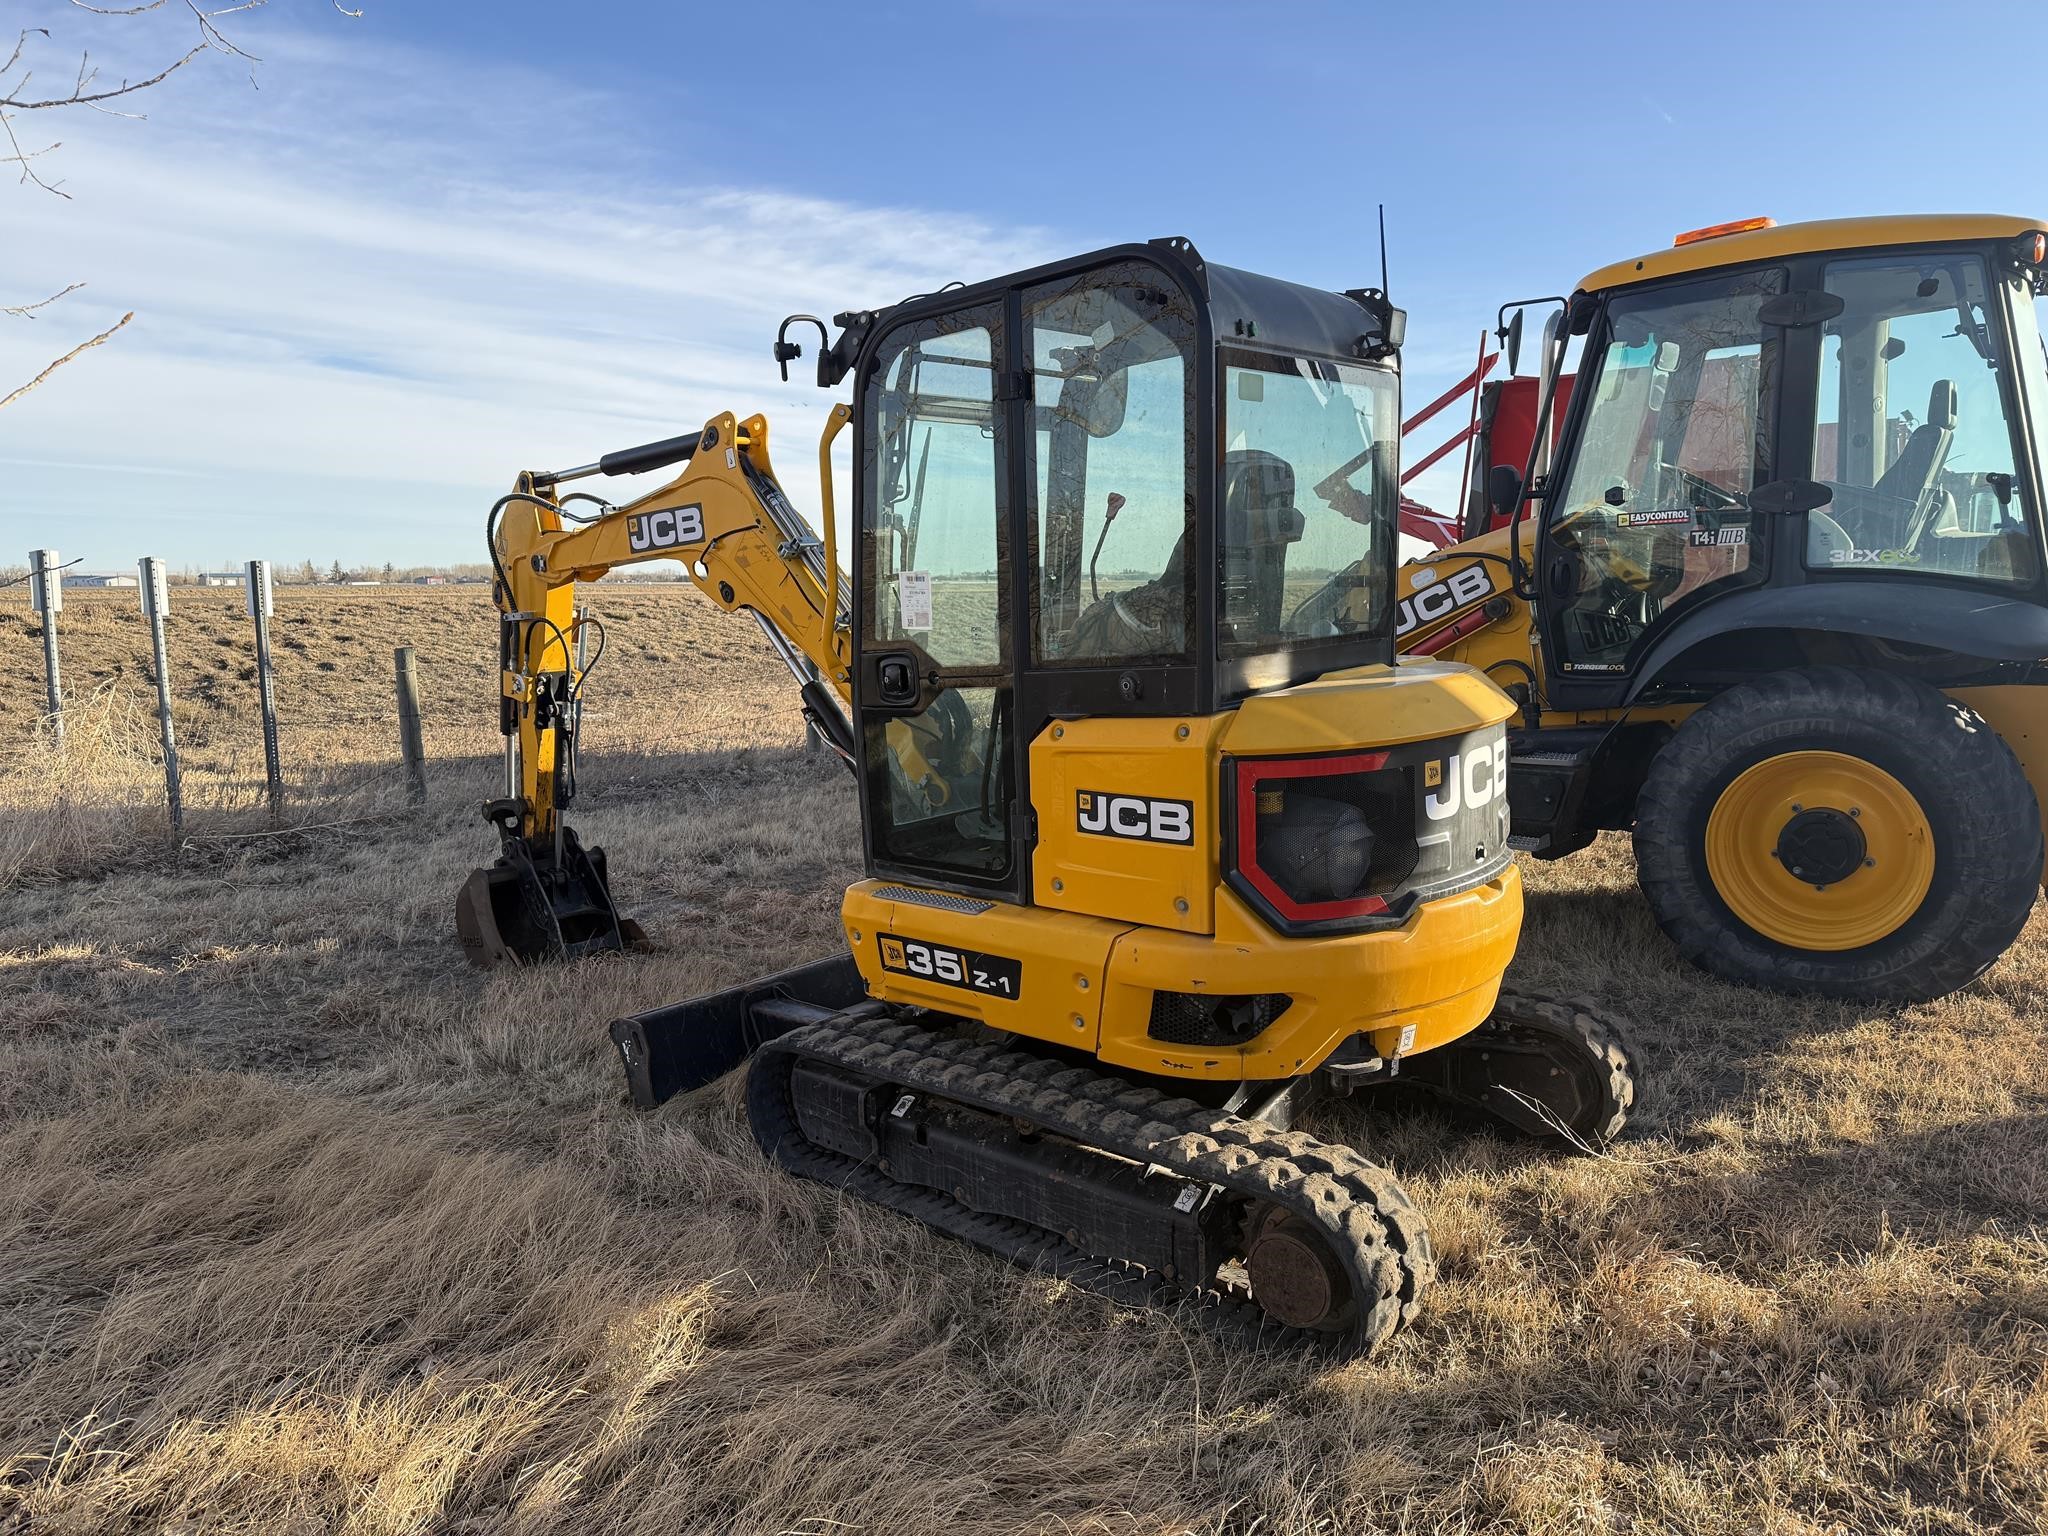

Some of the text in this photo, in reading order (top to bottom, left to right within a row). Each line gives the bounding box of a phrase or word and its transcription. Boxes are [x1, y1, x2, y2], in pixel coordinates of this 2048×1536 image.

[630, 507, 703, 550] JCB
[1630, 510, 1689, 525] EASYCONTROL
[1691, 531, 1716, 545] T4i
[1396, 566, 1491, 636] JCB
[1080, 795, 1191, 841] JCB
[906, 943, 1011, 993] 35 Z-1
